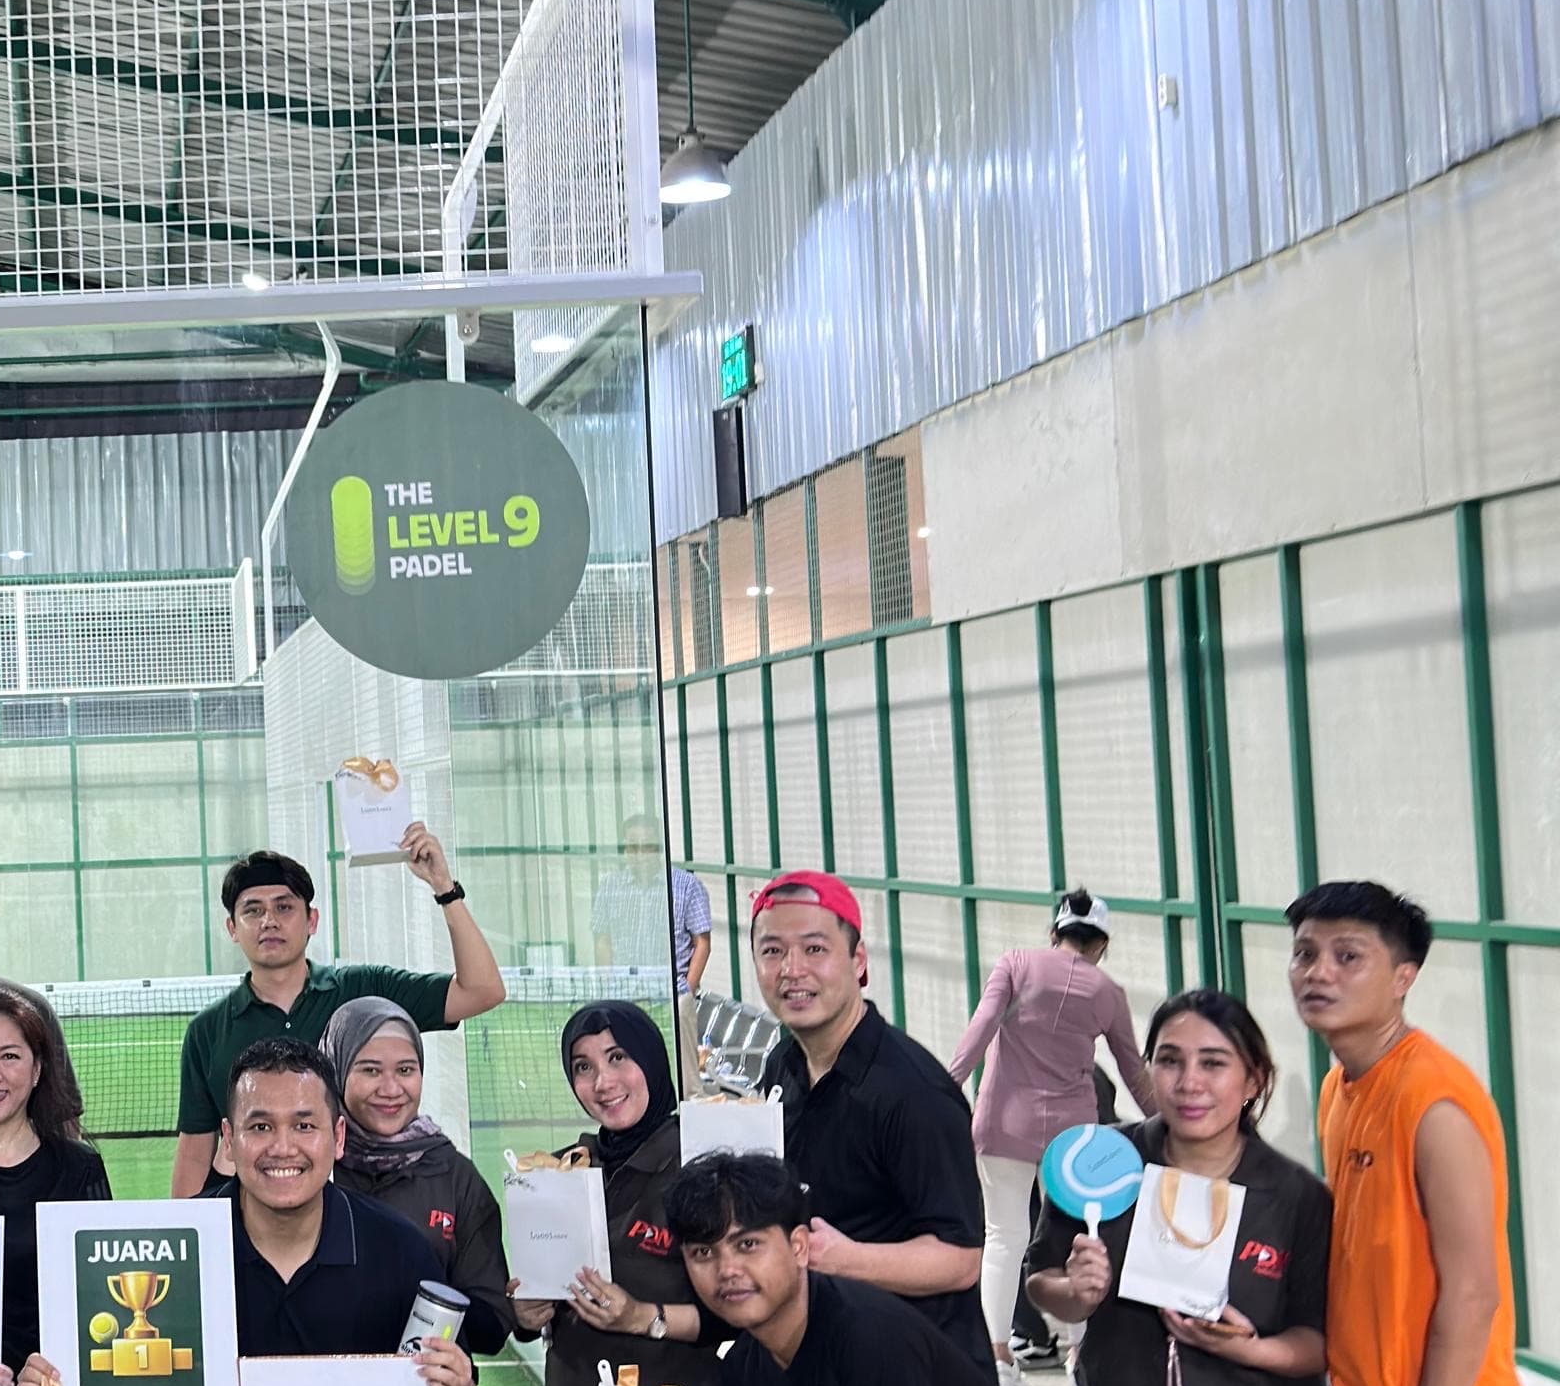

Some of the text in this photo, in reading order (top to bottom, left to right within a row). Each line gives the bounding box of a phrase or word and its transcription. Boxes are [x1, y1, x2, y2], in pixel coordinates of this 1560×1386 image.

[384, 482, 433, 506] THE
[390, 552, 472, 579] PADEL
[88, 1239, 187, 1263] JUARA I
[134, 1344, 148, 1369] 1
